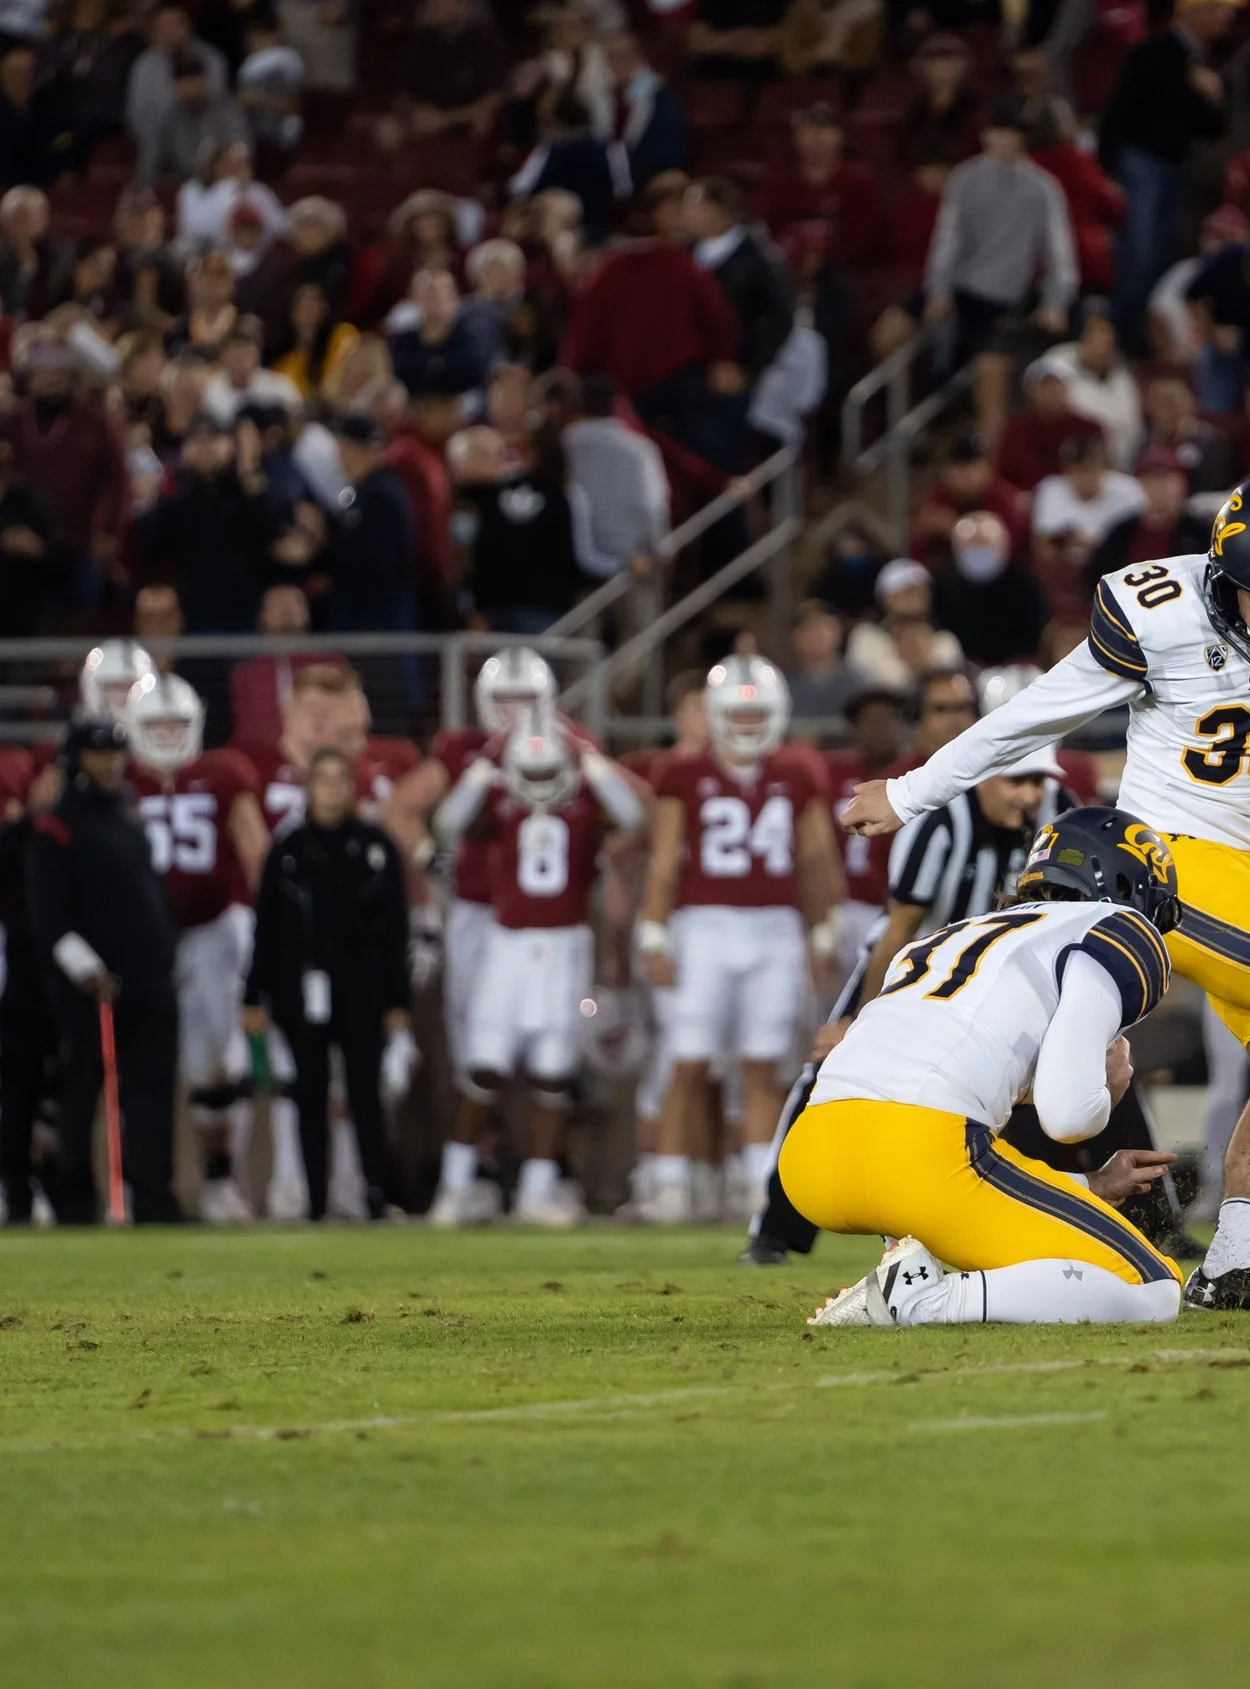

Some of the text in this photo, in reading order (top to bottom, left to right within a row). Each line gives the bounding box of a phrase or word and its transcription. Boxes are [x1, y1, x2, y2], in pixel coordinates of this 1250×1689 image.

[1123, 565, 1183, 610] 30
[139, 793, 218, 875] 55
[700, 796, 795, 878] 24
[877, 912, 1049, 1001] 37
